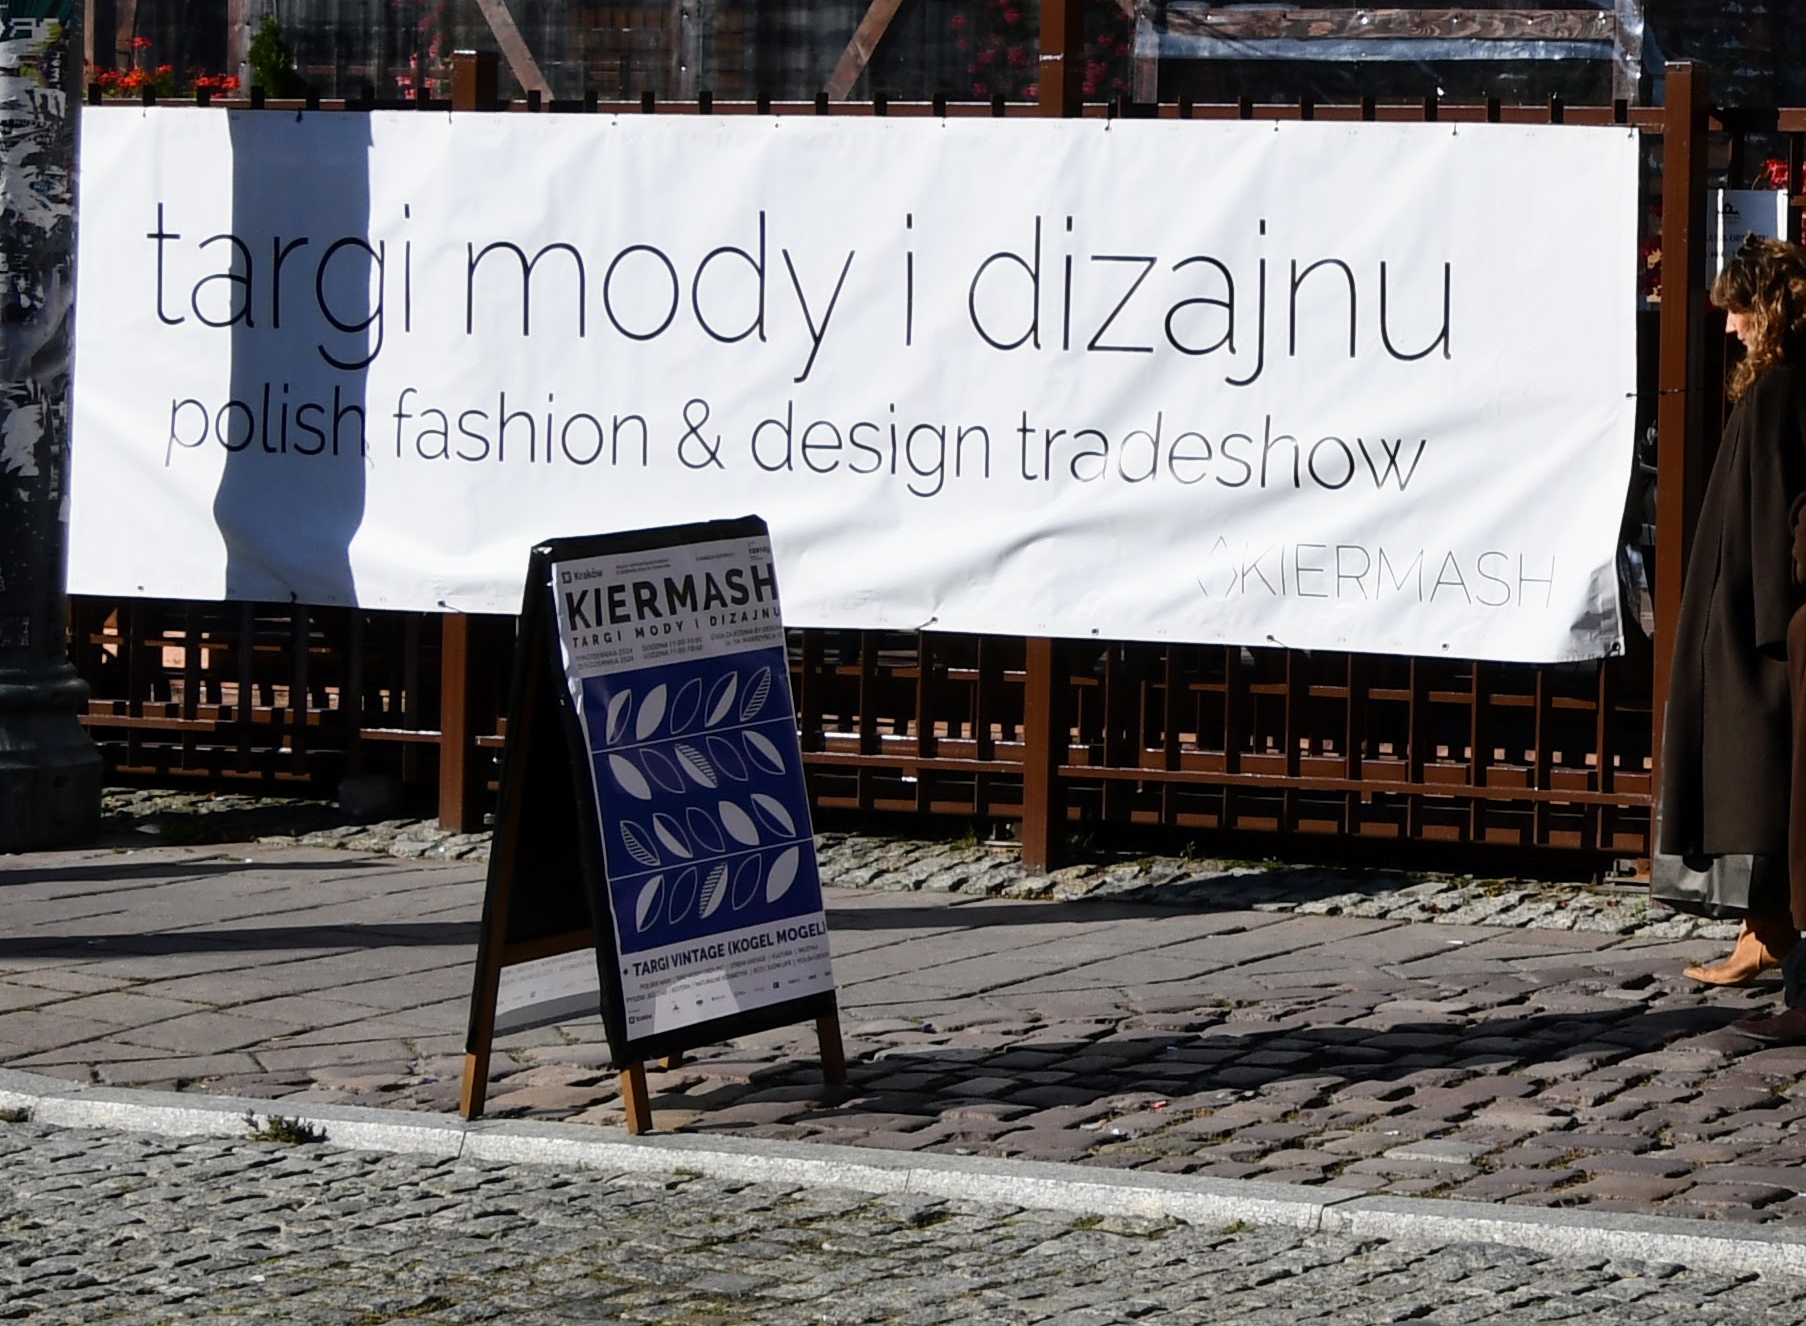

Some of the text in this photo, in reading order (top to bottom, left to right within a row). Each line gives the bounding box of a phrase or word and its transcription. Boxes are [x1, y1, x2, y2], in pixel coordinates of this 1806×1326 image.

[147, 193, 1452, 388] targi mody i dizajnu
[164, 382, 1428, 498] polish fashion & design tradeshow
[565, 563, 779, 631] KIERMASH
[1241, 540, 1557, 610] KIERMASH
[573, 633, 622, 648] TARGI
[635, 621, 683, 639] MODY
[710, 607, 781, 627] DIZAJNU
[633, 960, 670, 977] TARGI
[671, 943, 725, 966] VINTAGE
[728, 933, 774, 955] (KOGEL
[777, 920, 826, 944] MOGEL)
